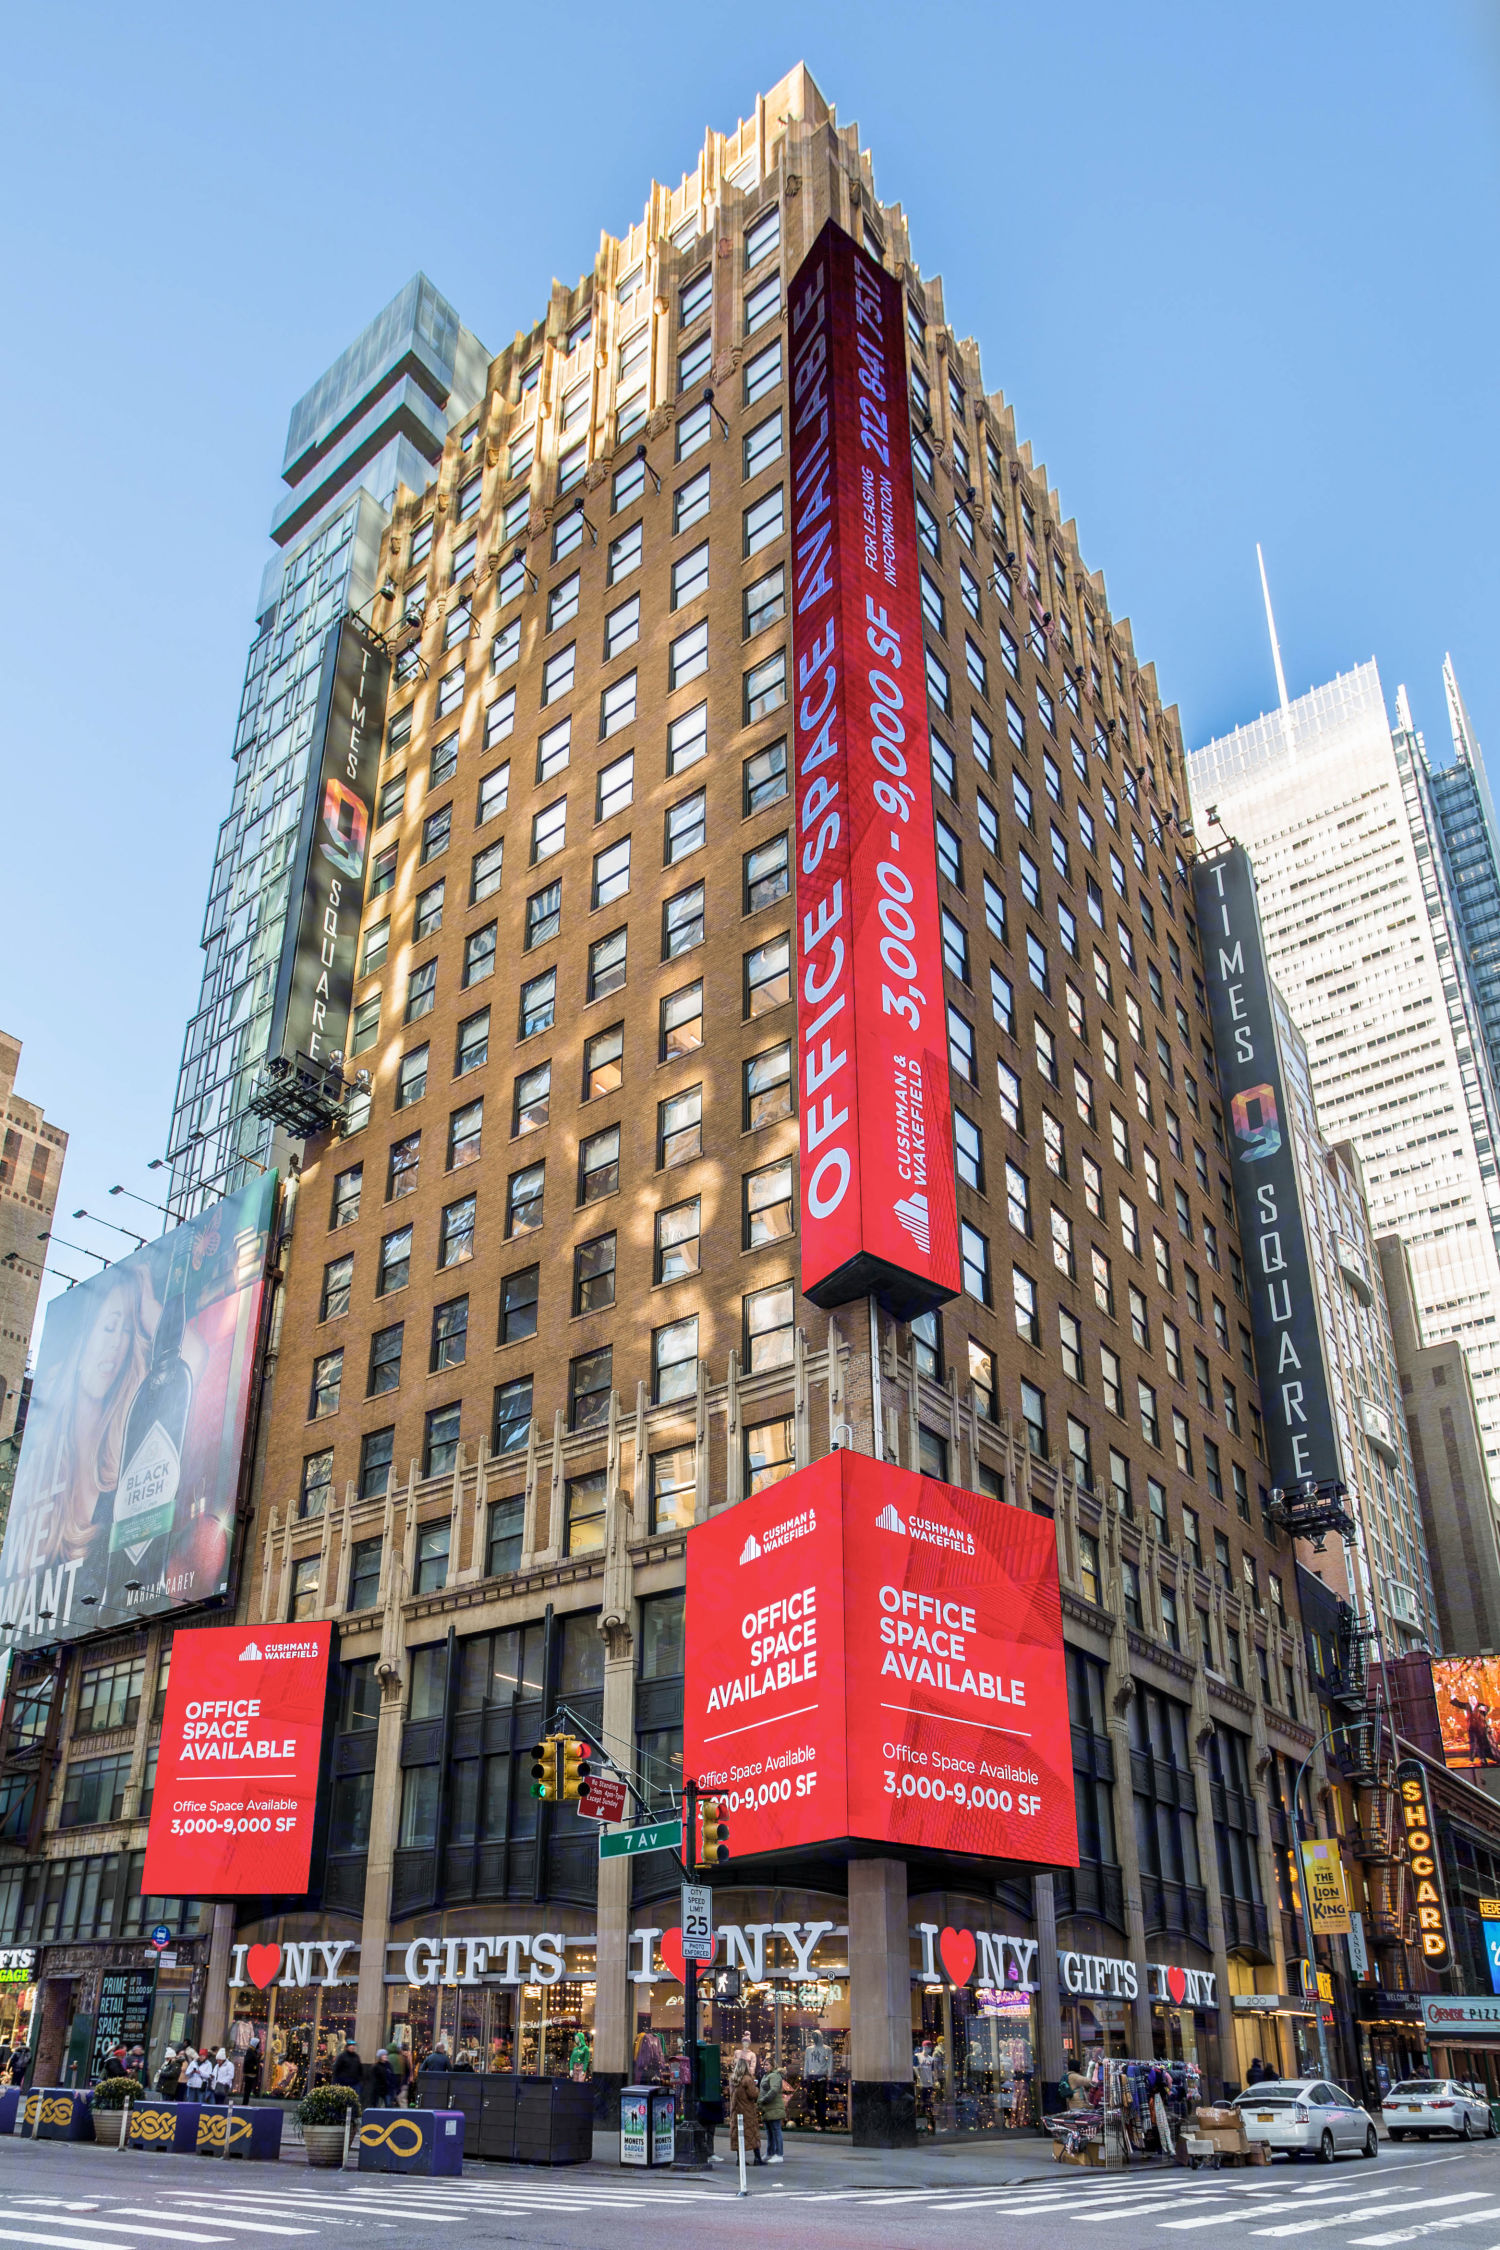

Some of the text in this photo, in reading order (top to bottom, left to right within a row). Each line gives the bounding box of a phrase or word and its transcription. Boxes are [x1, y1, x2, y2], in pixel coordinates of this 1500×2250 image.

[854, 255, 890, 468] 212 841 7517
[859, 466, 877, 574] FOR LEASING
[883, 475, 898, 588] INFORMATION
[865, 595, 902, 670] SF
[346, 647, 370, 780] TIMES
[793, 262, 851, 1220] OFFICE SPACE AVAILABLE
[868, 669, 916, 818] 9,000
[876, 862, 928, 1032] 3,000
[1209, 862, 1255, 1065] TIMES
[309, 878, 342, 1061] SQUARE
[893, 1055, 912, 1181] CUSHMAN &
[908, 1058, 929, 1187] WAKEFIELD
[1258, 1183, 1313, 1479] SQUARE
[127, 1461, 169, 1491] BLACK
[128, 1480, 164, 1505] IRISH
[6, 1502, 55, 1578] WE
[763, 1509, 816, 1542] CUSHMAN &
[763, 1520, 817, 1555] WAKEFIELD
[909, 1516, 974, 1544] CUSHMAN &
[909, 1526, 975, 1556] WAKEFIELD
[0, 1557, 84, 1644] WANT
[126, 1571, 195, 1607] MARIAH CAREY
[878, 1586, 976, 1634] OFFICE
[742, 1586, 816, 1639] OFFICE
[265, 1643, 310, 1652] CUSHMAN
[265, 1650, 318, 1660] WAKEFIELD
[750, 1618, 816, 1667] SPACE
[879, 1617, 966, 1661] SPACE
[706, 1651, 817, 1714] AVAILABLE
[880, 1651, 1026, 1706] AVAILABLE
[182, 1721, 248, 1740] SPACE
[185, 1700, 260, 1719] OFFICE
[179, 1740, 296, 1760] AVAILABLE
[698, 1745, 815, 1789] Office Space Available
[882, 1743, 1039, 1785] Office Space Available
[796, 1771, 817, 1797] SF
[884, 1770, 1041, 1816] 3,000-9,000 SF
[170, 1817, 296, 1836] 3,000-9,000 SF
[173, 1799, 297, 1814] Office Space Available
[624, 1835, 632, 1850] 7
[1314, 1873, 1334, 1882] THE
[1402, 1780, 1446, 1956] SHOCARD
[688, 1897, 705, 1905] SPEED
[689, 1905, 704, 1913] LIMIT
[686, 1915, 708, 1936] 25
[279, 1940, 356, 1987] NY
[405, 1933, 566, 1986] GIFTS
[685, 1949, 709, 1957] ENFORCED
[718, 1921, 837, 1983] NY
[976, 1930, 1038, 1992] NY
[102, 1977, 128, 1994] PRIME
[1062, 1951, 1138, 1999] GIFTS
[1184, 1970, 1216, 2006] NY
[100, 1997, 124, 2014] RETAIL
[1246, 1997, 1266, 2005] 200
[97, 2017, 123, 2034] SPACE
